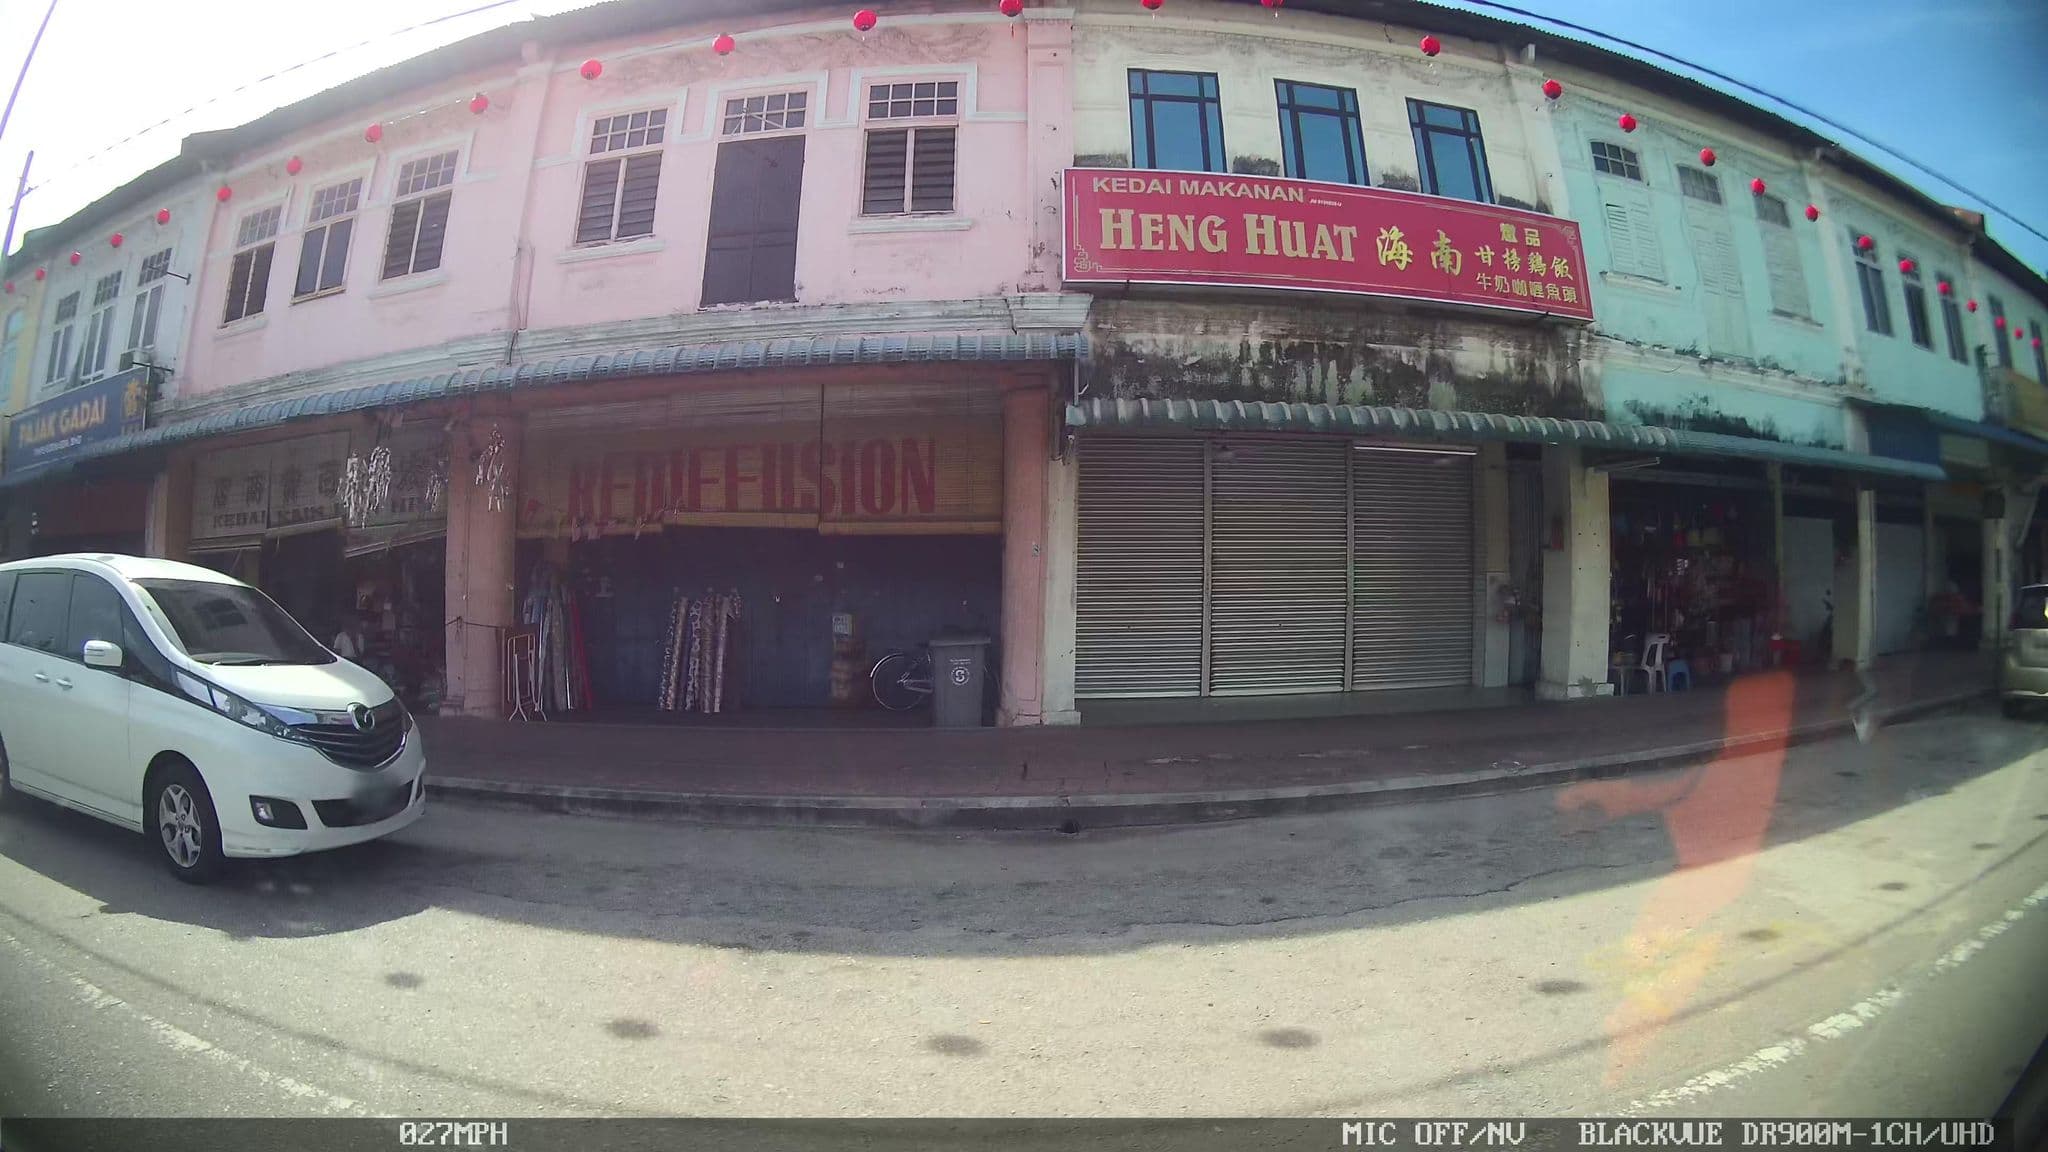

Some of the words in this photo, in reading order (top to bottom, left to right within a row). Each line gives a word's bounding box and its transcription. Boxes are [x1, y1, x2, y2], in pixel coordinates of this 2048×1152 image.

[1092, 177, 1172, 195] KEDAI
[1179, 179, 1305, 203] MAKANAN
[1099, 208, 1228, 253] HENG
[1243, 213, 1358, 263] HUAT
[1376, 225, 1462, 276] 海南
[59, 395, 108, 434] GADAI
